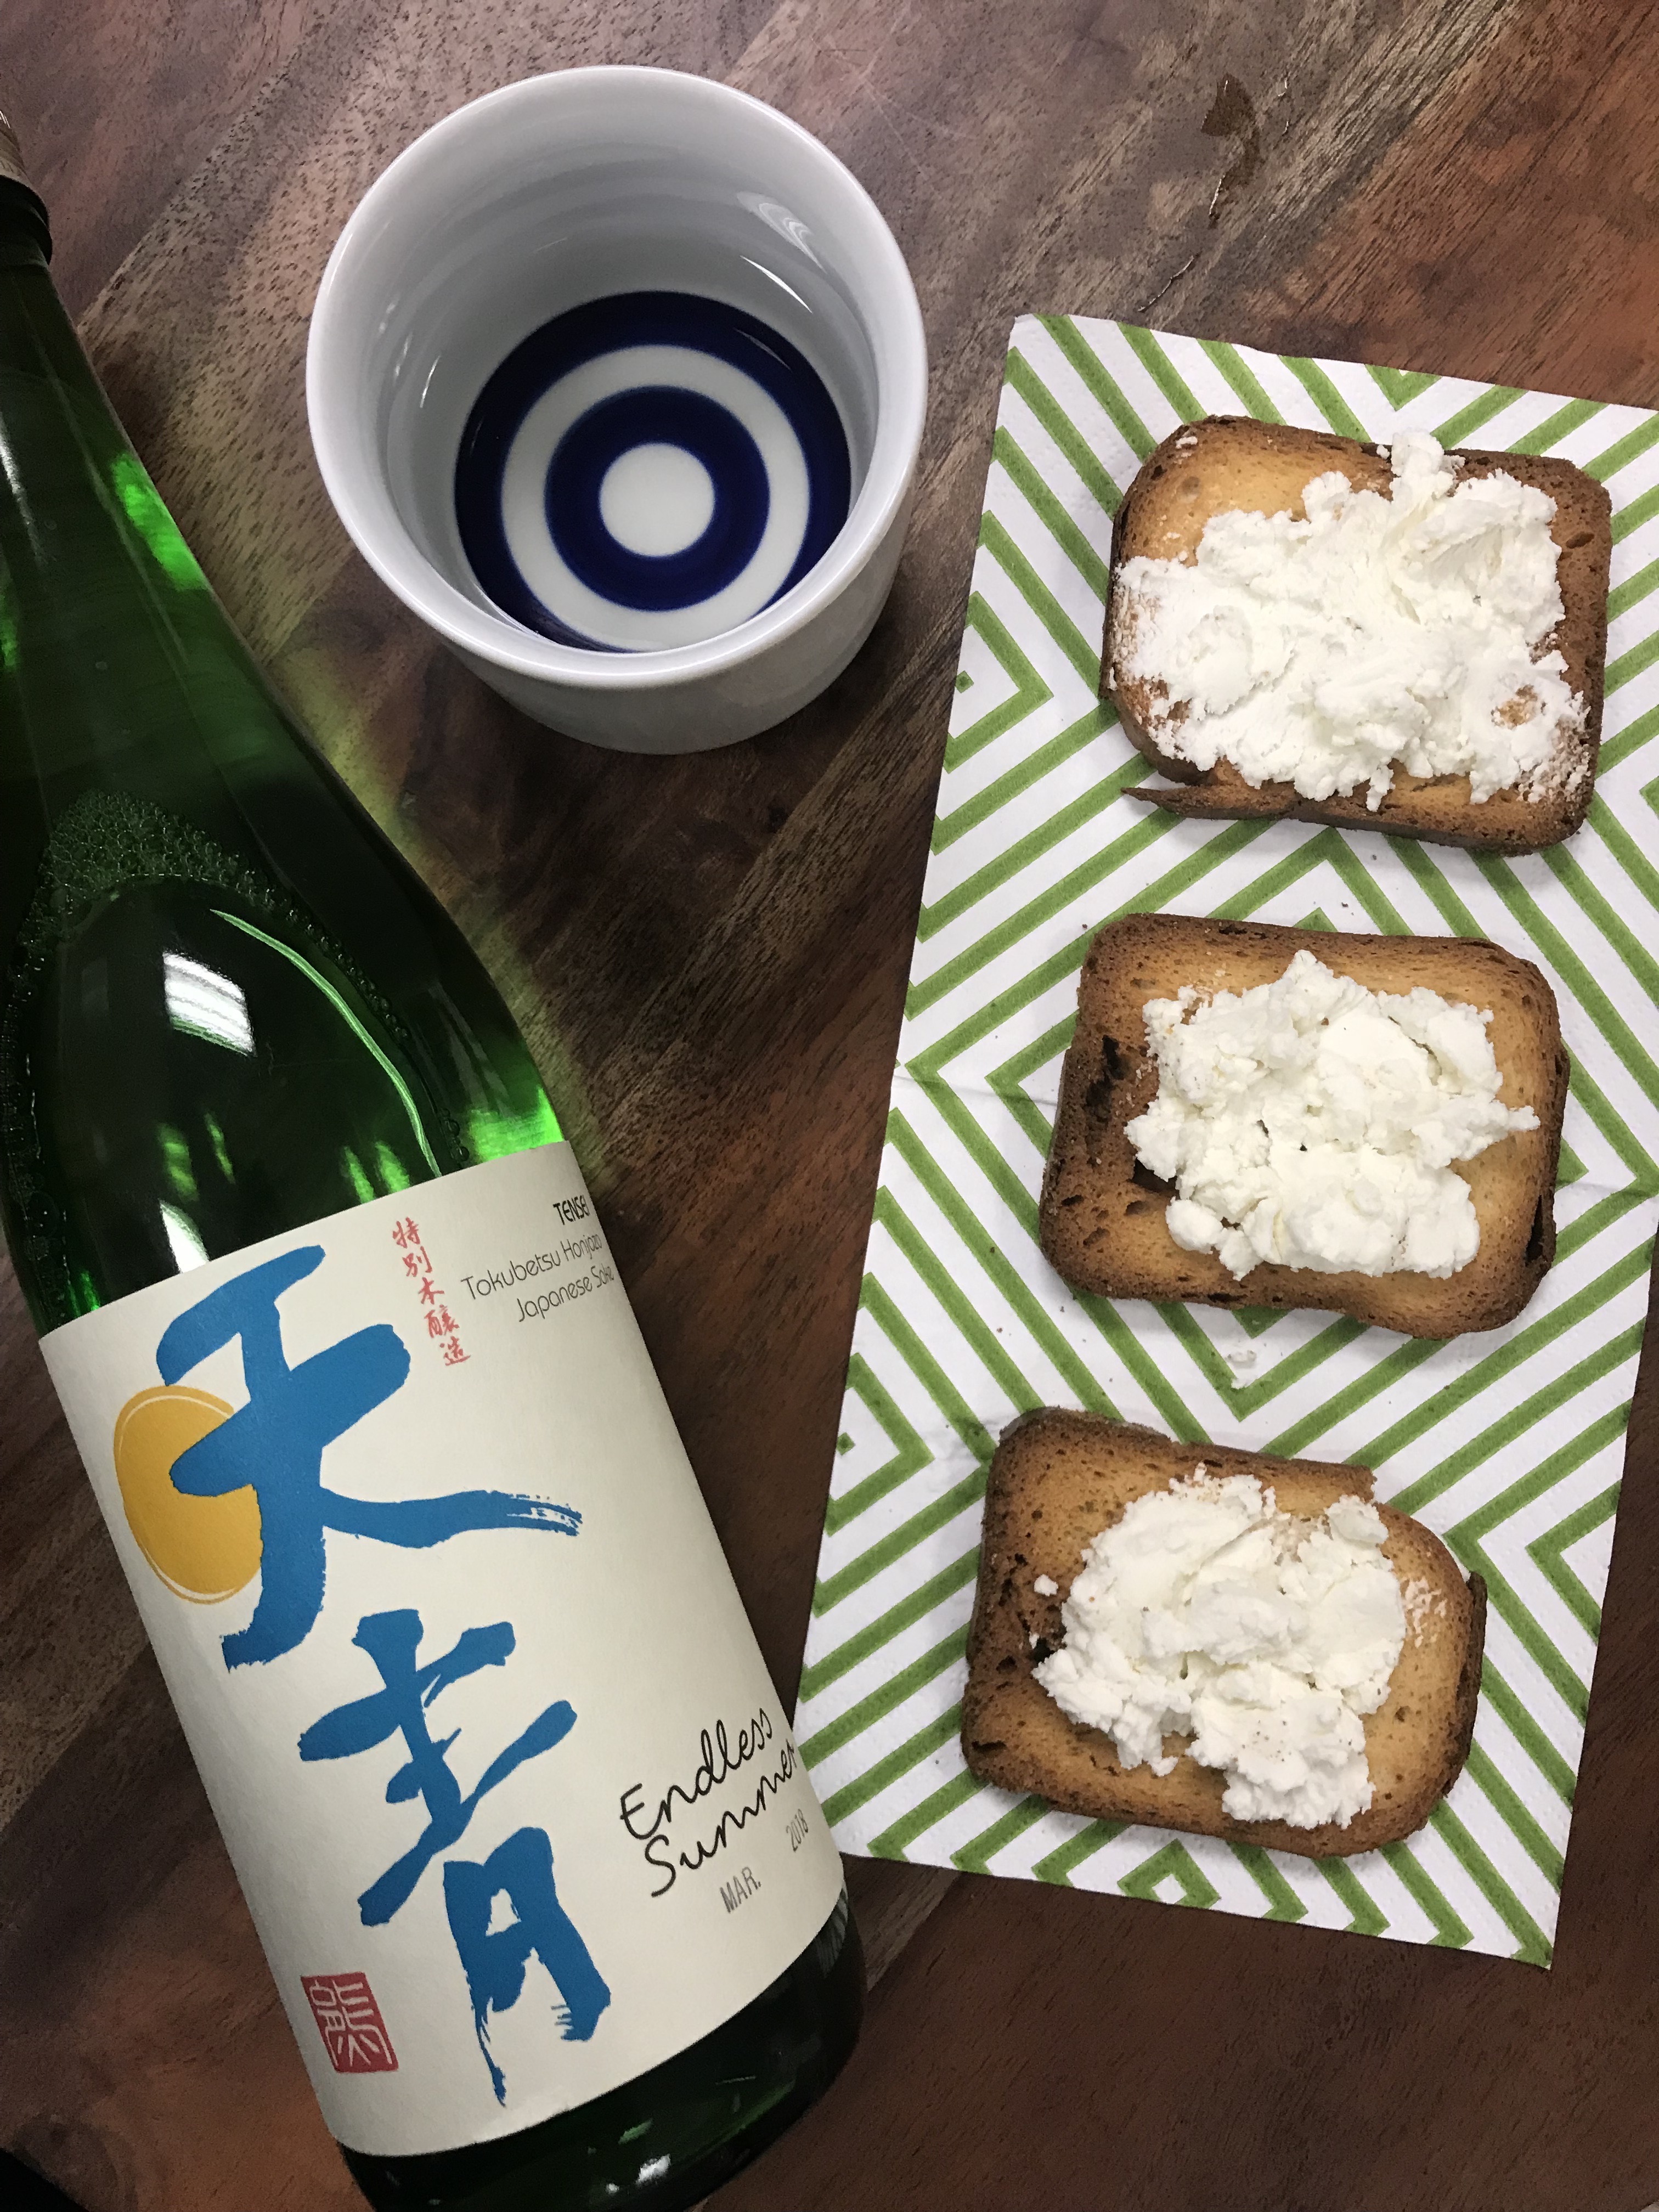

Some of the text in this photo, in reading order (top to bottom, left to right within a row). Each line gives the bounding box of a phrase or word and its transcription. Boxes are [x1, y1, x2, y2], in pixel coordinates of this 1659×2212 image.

[460, 1250, 561, 1300] Tokubetsu
[516, 1263, 614, 1323] Japanese Sake
[156, 1245, 611, 2106] 天青
[620, 1707, 772, 1840] Endless
[645, 1738, 797, 1897] Summer
[719, 1808, 810, 1914] MAR. 2018
